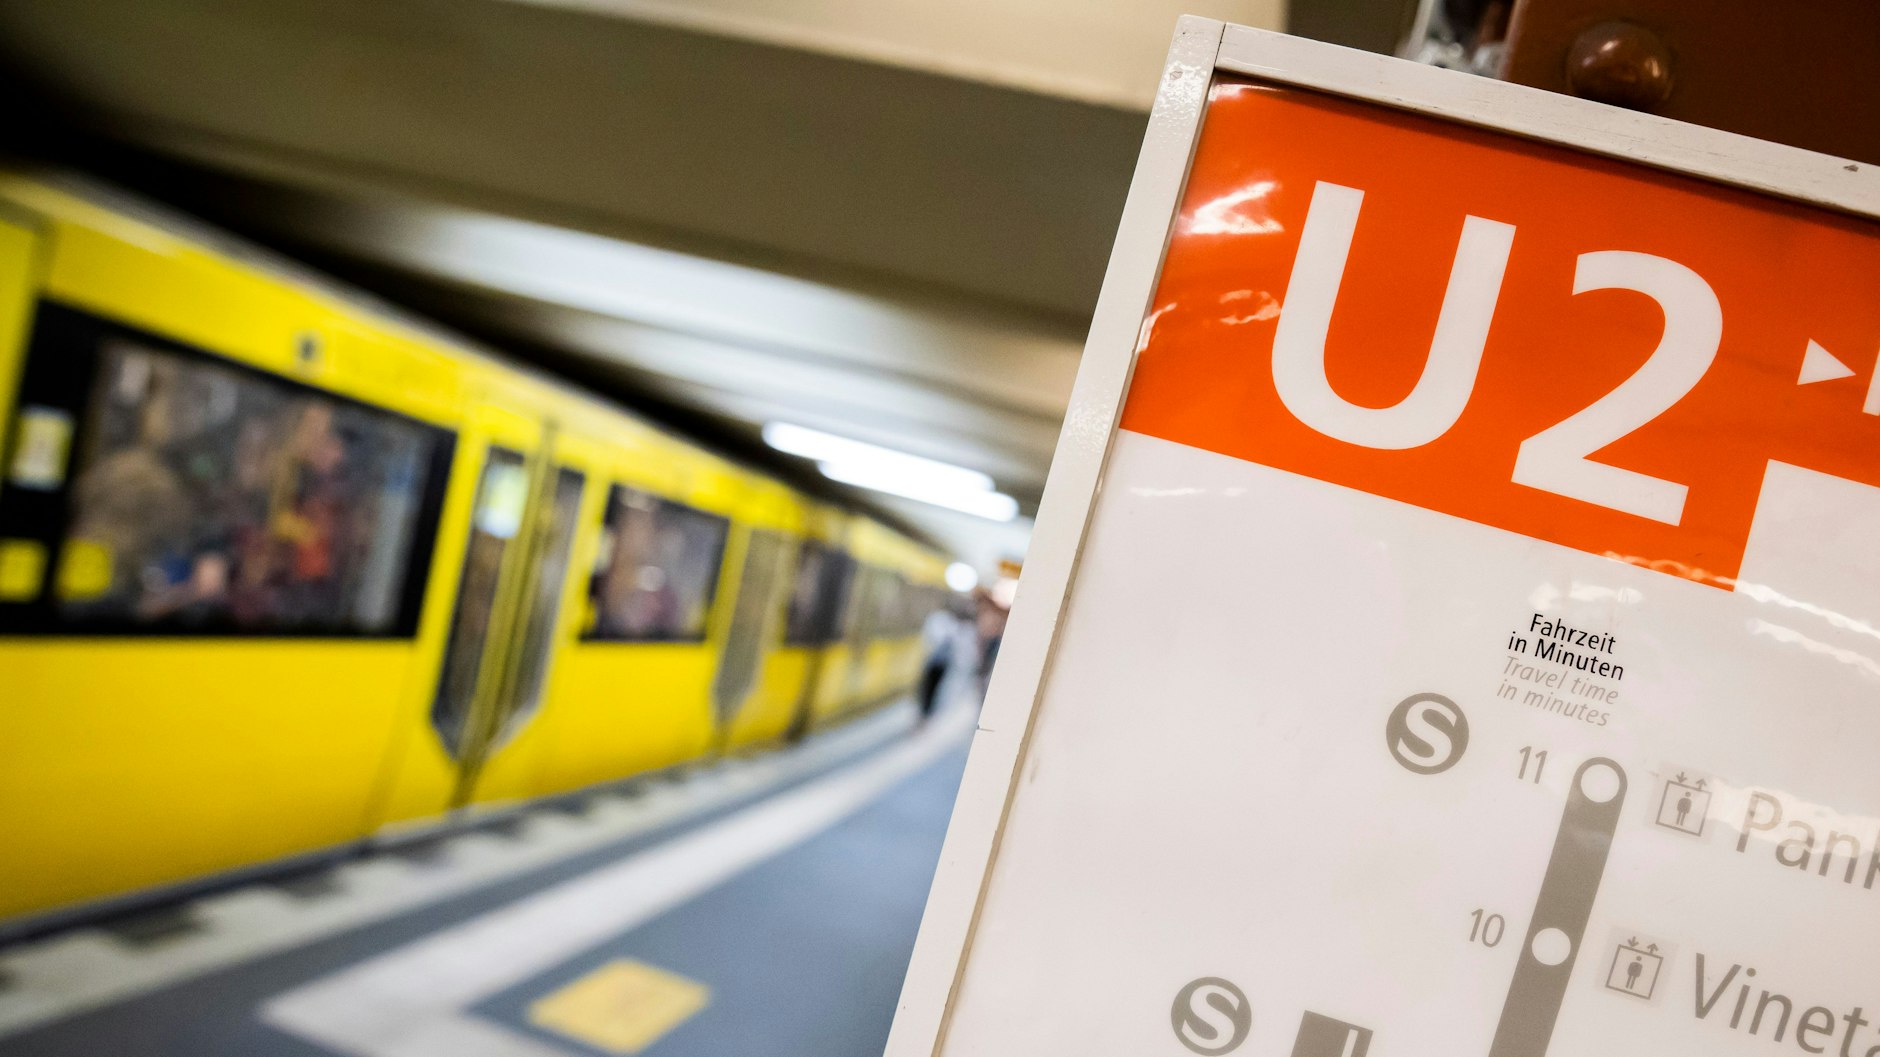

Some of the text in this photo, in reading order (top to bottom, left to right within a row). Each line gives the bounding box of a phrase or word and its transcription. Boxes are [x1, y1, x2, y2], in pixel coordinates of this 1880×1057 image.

[1271, 180, 1724, 528] U2
[1507, 630, 1624, 681] in Minuten
[1529, 612, 1617, 655] Fahrzeit
[1496, 678, 1611, 727] in minutes
[1503, 655, 1619, 705] Travel time
[1396, 700, 1458, 768] S
[1517, 745, 1549, 785] 11
[1468, 907, 1506, 948] 10
[1181, 984, 1241, 1050] S
[1694, 952, 1880, 1057] Vinet
